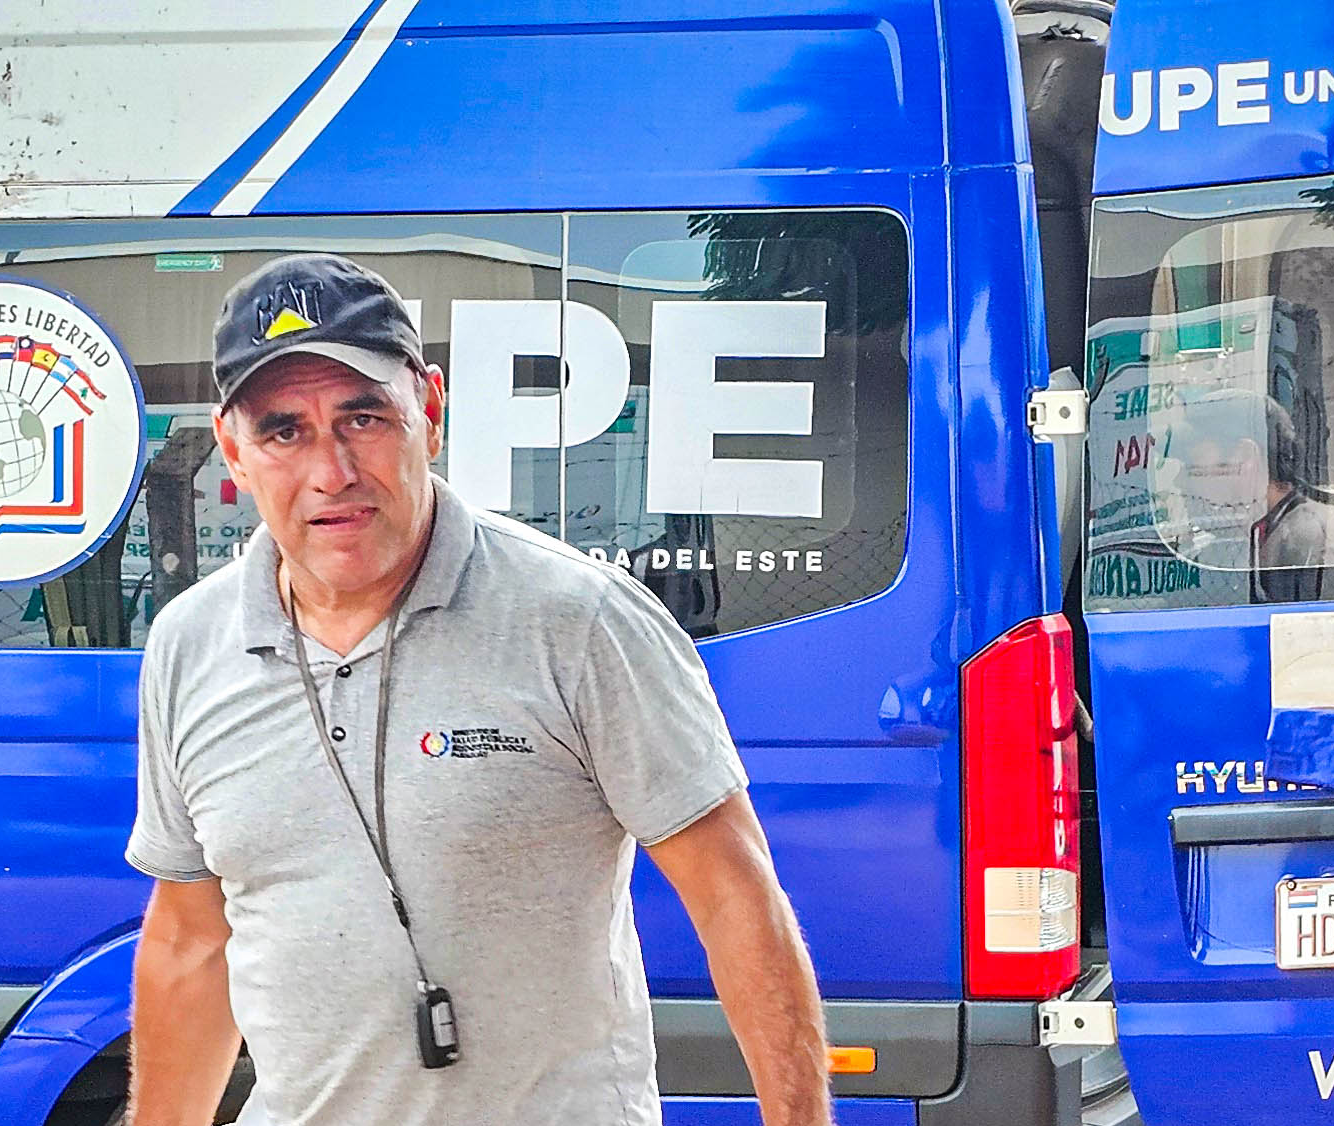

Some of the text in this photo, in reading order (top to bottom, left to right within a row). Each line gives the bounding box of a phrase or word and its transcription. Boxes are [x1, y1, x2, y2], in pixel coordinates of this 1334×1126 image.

[1099, 60, 1270, 136] UPE
[25, 307, 111, 369] LIBERTAD
[407, 299, 827, 518] PE
[651, 548, 715, 571] DEL
[735, 549, 824, 572] ESTE
